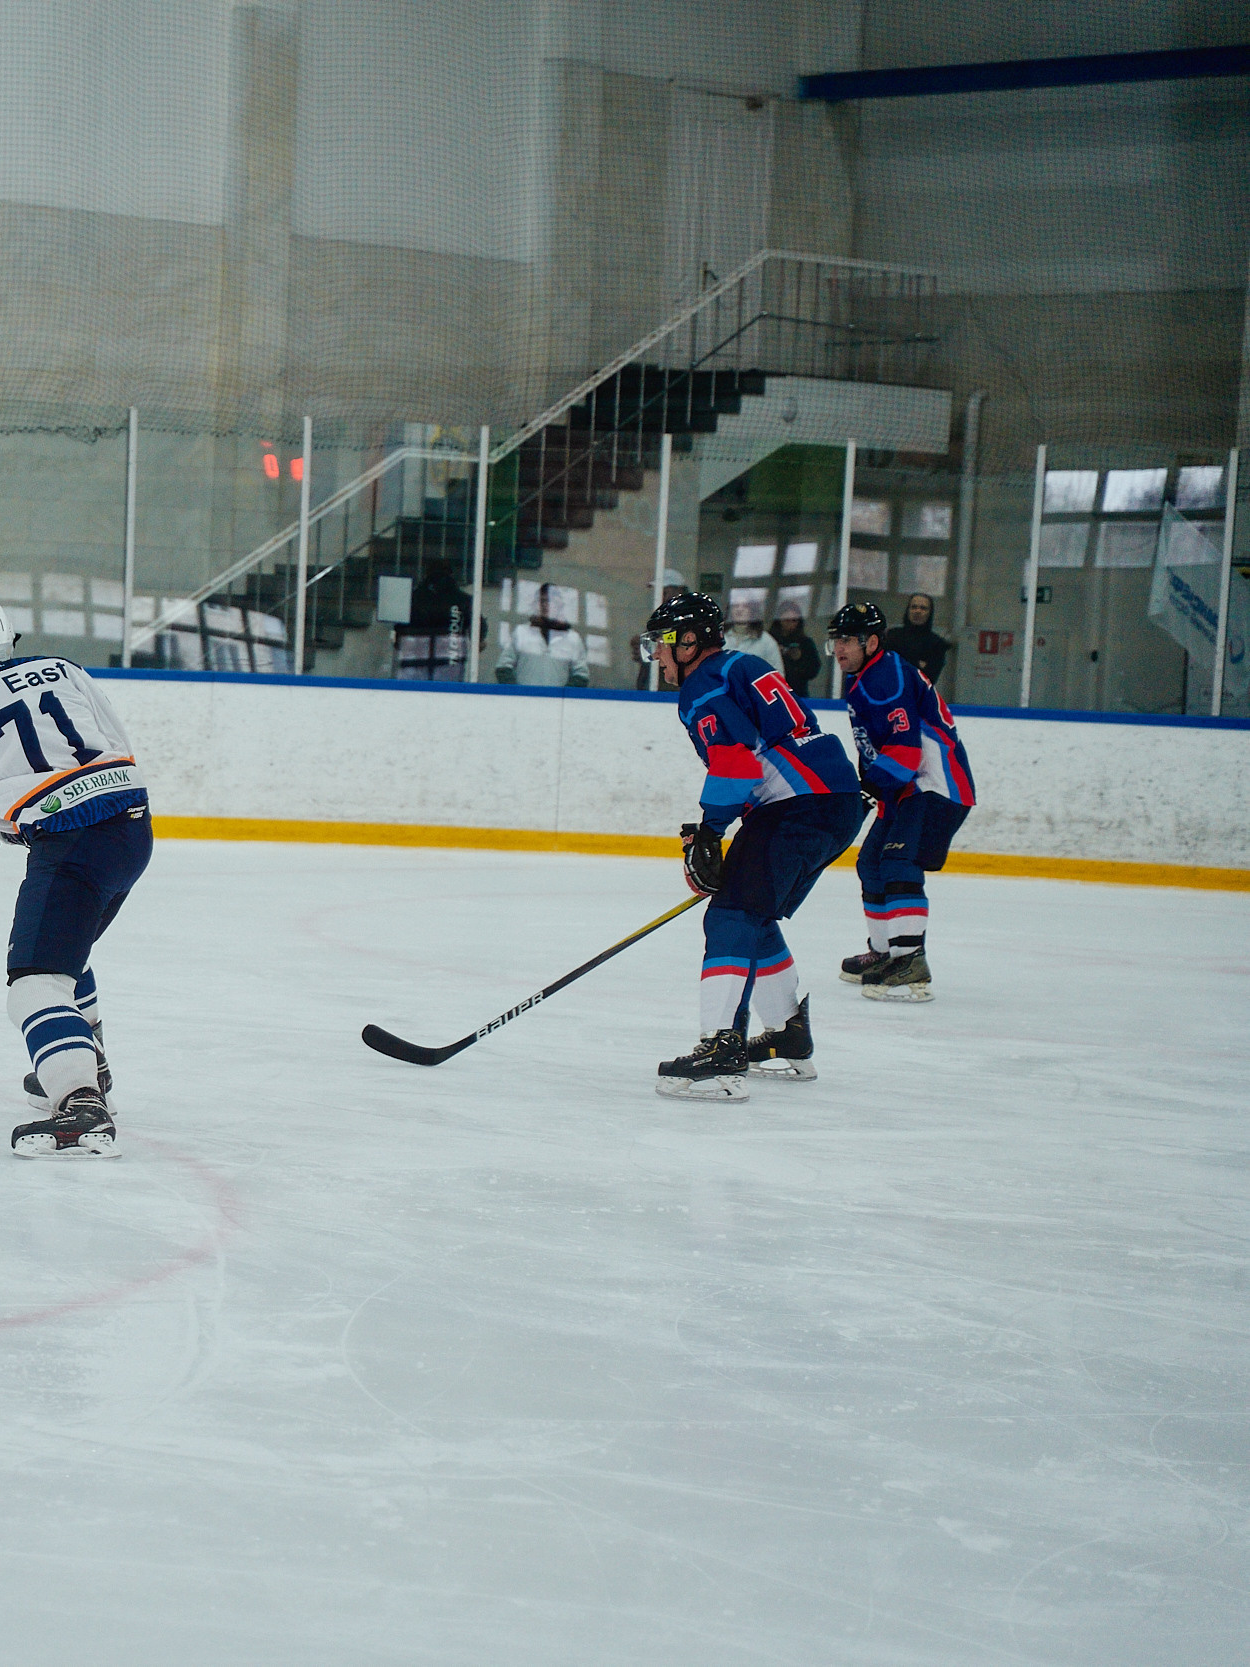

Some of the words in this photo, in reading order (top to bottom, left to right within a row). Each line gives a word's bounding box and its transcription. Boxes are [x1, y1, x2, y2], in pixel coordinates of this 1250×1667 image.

[1, 661, 70, 694] East
[63, 769, 131, 801] SBERBANK
[477, 991, 543, 1041] BAUER
